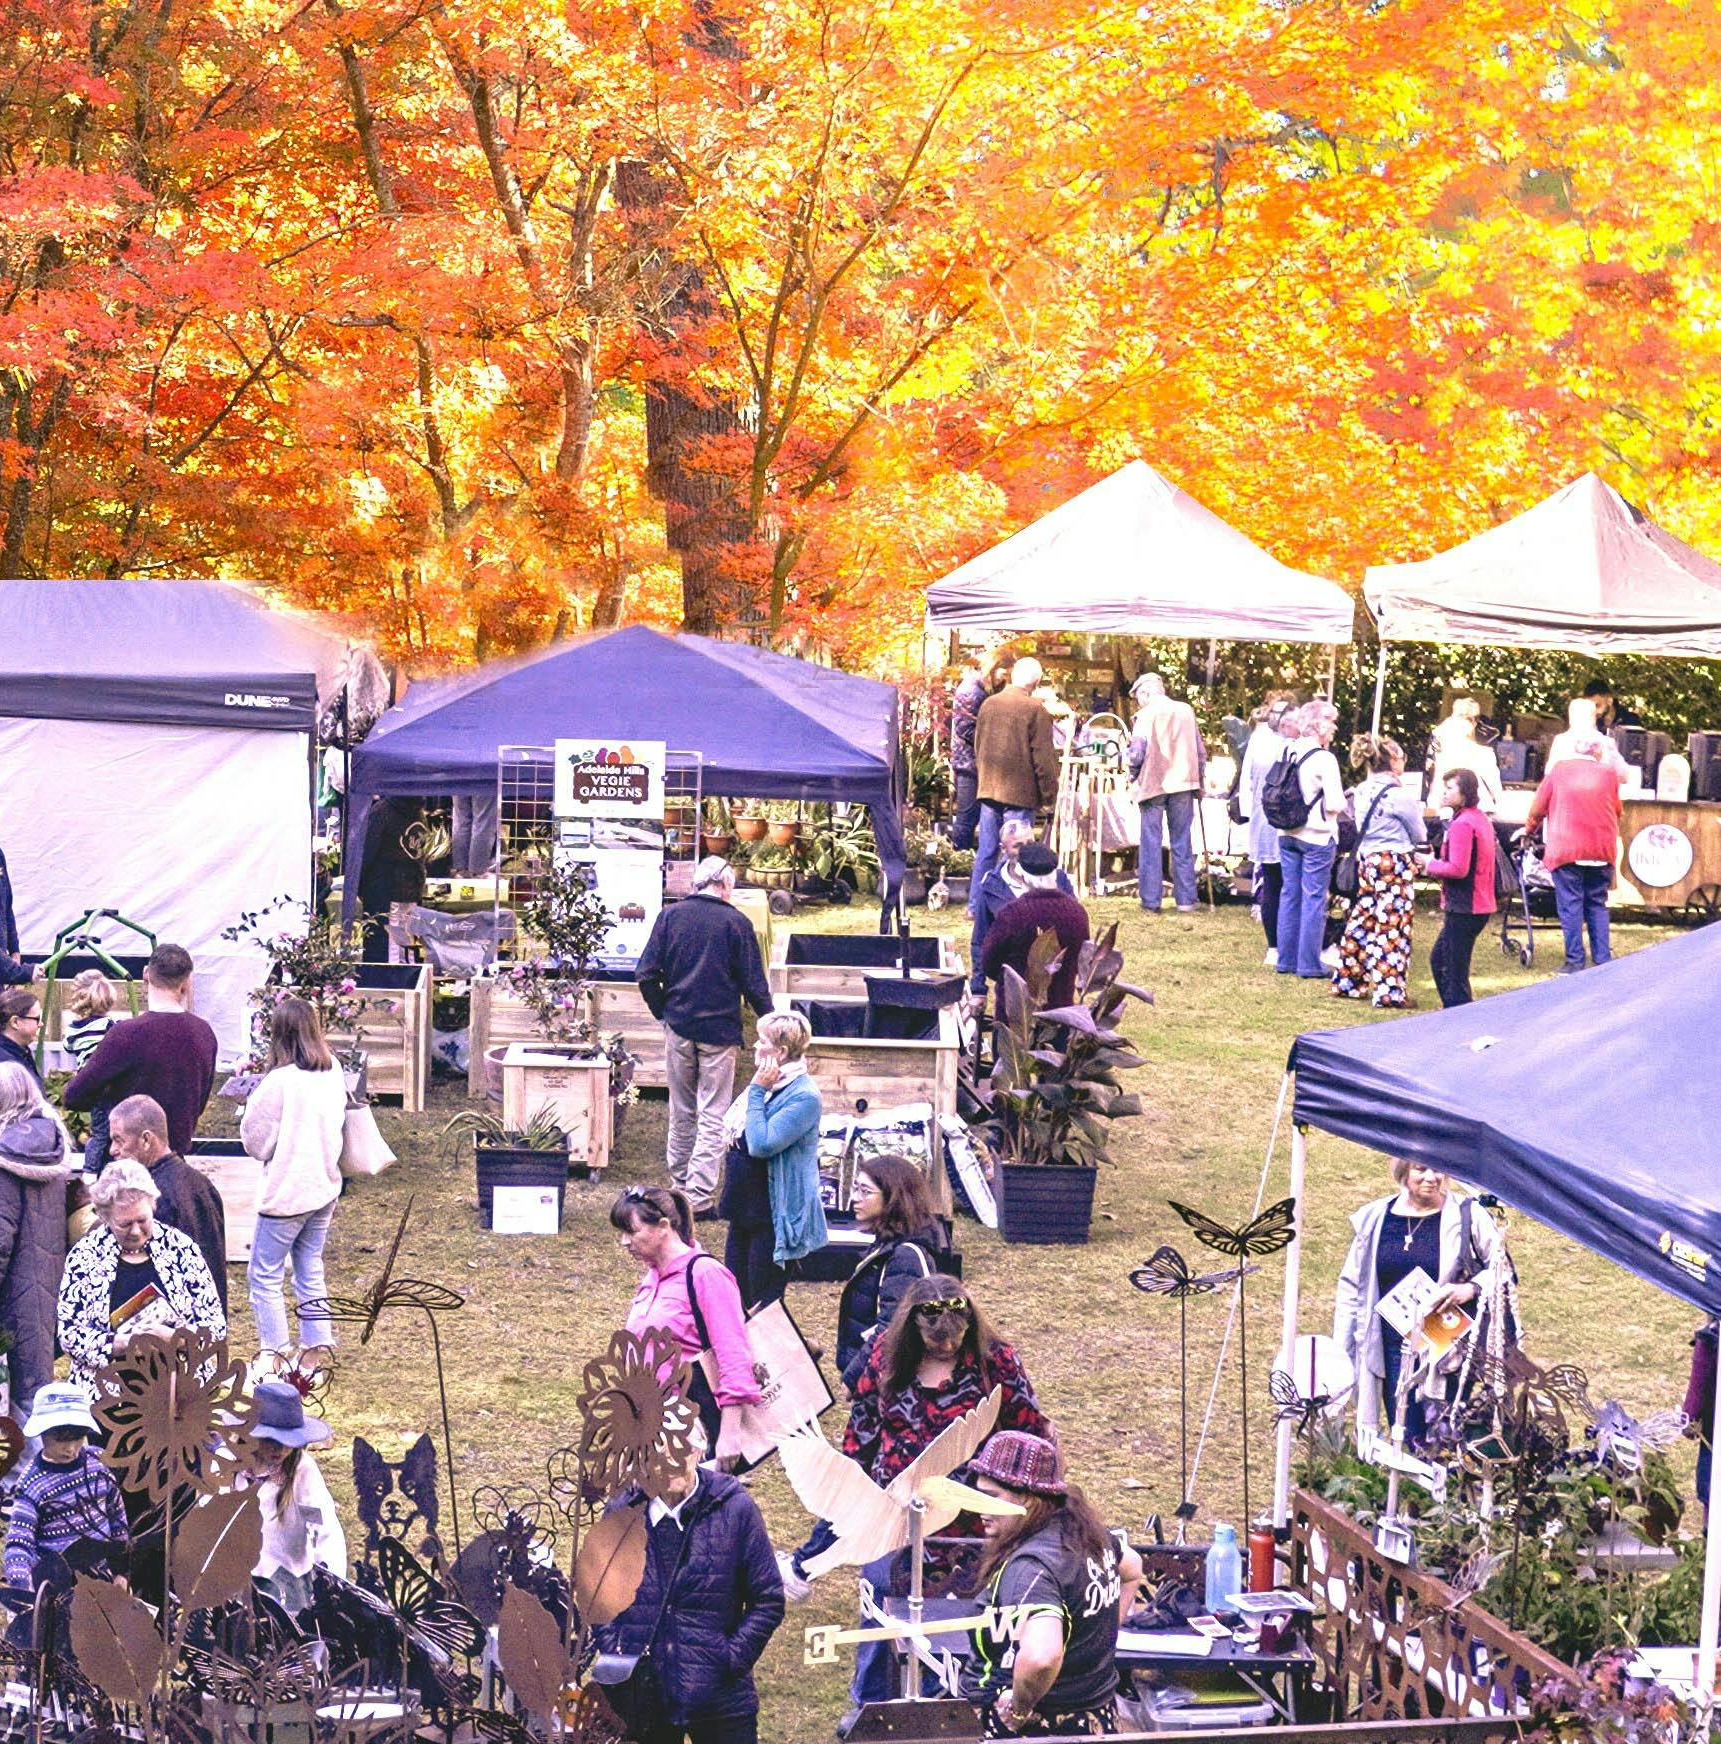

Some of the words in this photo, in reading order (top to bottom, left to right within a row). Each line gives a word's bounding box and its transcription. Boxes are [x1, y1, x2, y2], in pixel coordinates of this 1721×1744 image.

[224, 693, 272, 708] DUNE
[591, 775, 631, 786] VEGIE
[579, 786, 643, 798] GARDENS
